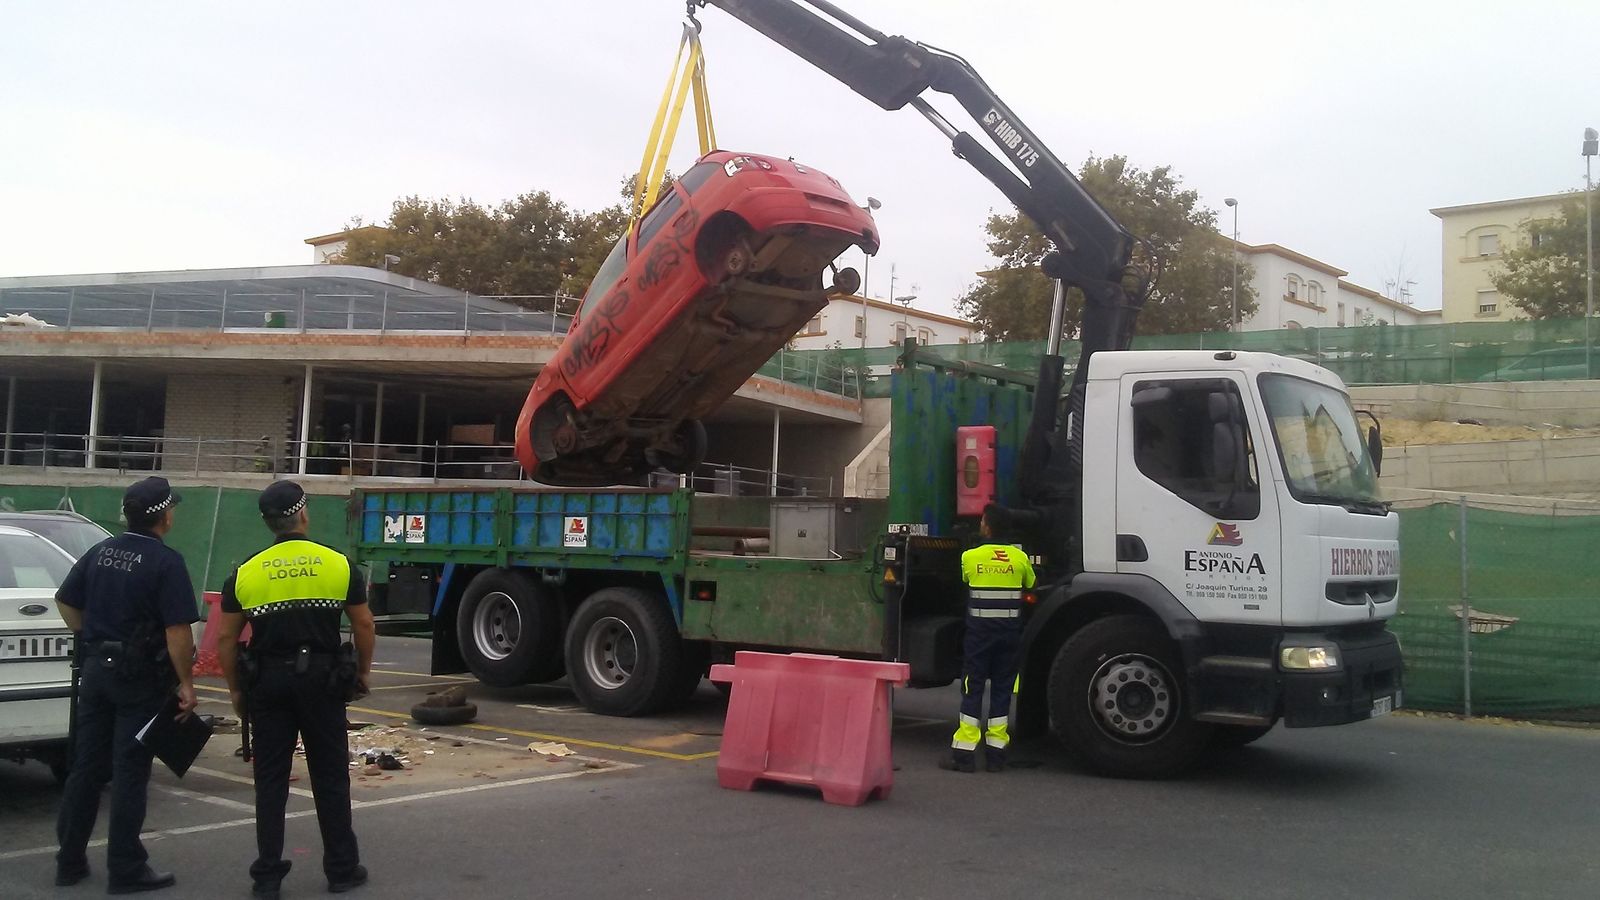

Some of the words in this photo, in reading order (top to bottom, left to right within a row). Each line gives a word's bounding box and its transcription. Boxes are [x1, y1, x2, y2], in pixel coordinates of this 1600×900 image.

[994, 120, 1023, 150] HIAB
[1016, 142, 1040, 168] 175
[97, 555, 133, 572] LOCAL
[1184, 550, 1267, 575] ESPAÑA
[1199, 551, 1233, 559] ANTONIO
[1331, 547, 1373, 576] HIERROS
[268, 567, 318, 580] LOCAL
